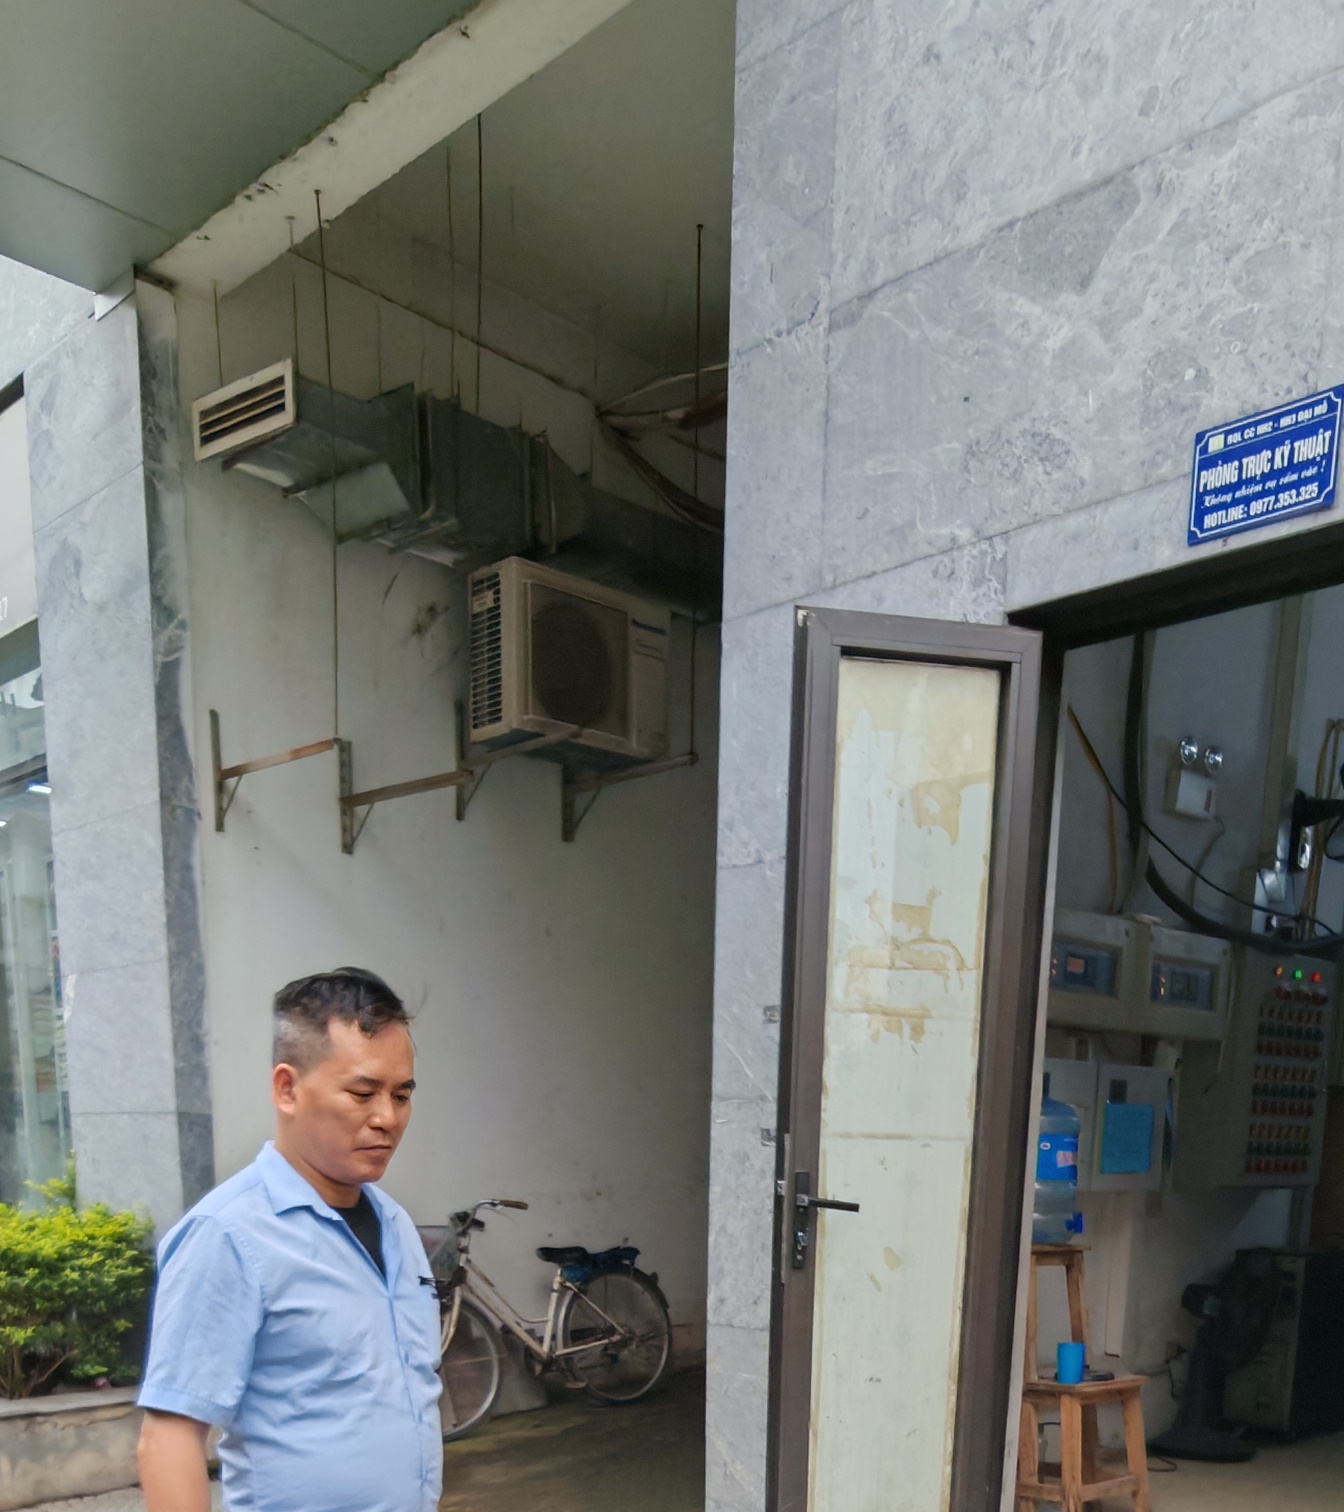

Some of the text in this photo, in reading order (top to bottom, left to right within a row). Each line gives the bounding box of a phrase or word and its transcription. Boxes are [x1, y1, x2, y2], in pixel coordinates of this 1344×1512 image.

[1199, 428, 1332, 492] PHÒNG TRỰC KỸ THUẬT
[1204, 482, 1318, 529] HOTLINE: 0977.353.325
